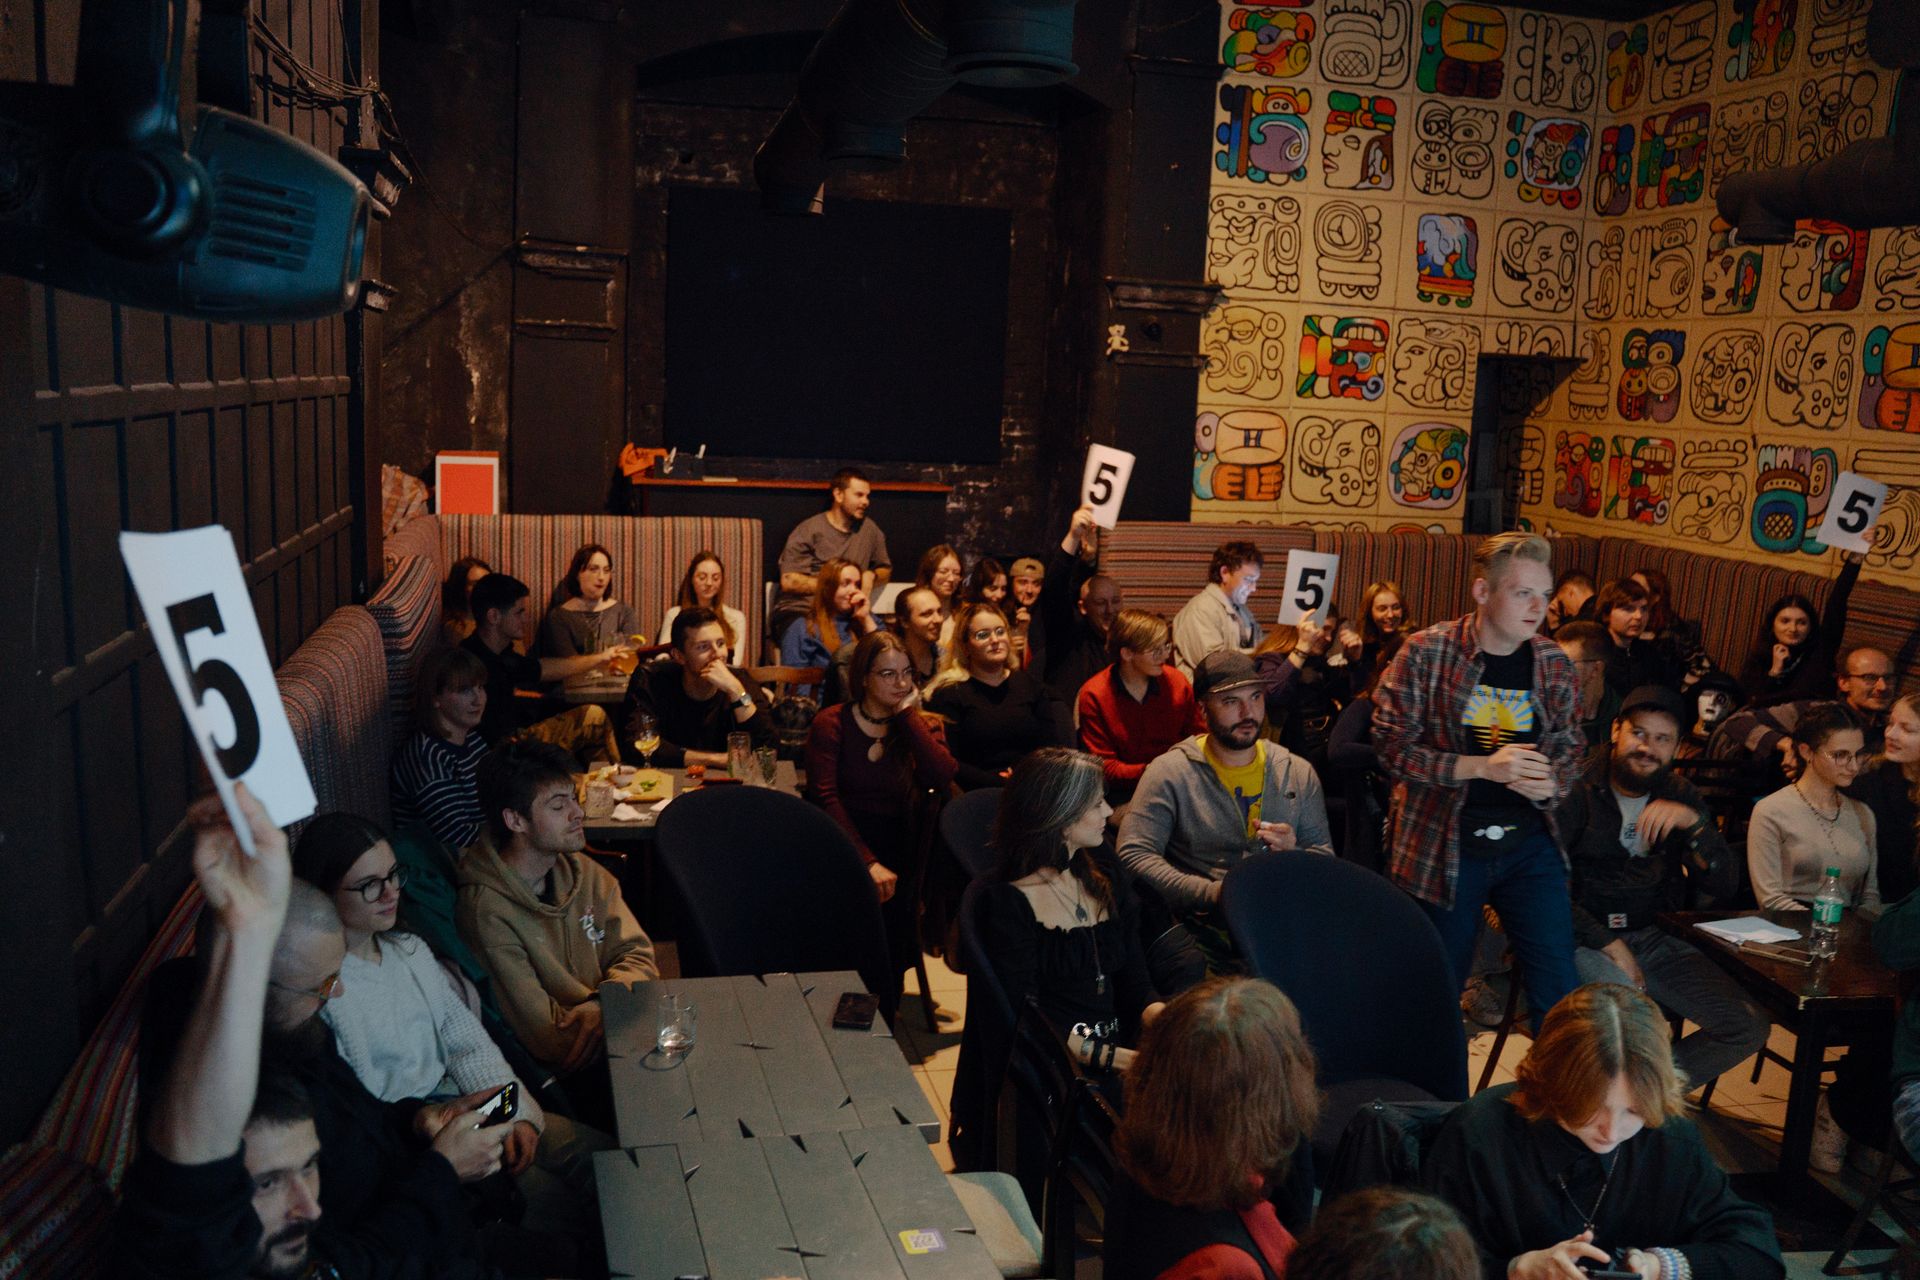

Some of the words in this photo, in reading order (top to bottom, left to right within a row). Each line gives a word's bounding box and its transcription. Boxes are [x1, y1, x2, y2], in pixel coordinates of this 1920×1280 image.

[1089, 463, 1117, 505] 5
[1837, 490, 1876, 533] 5
[1295, 567, 1326, 611] 5
[166, 592, 260, 779] 5
